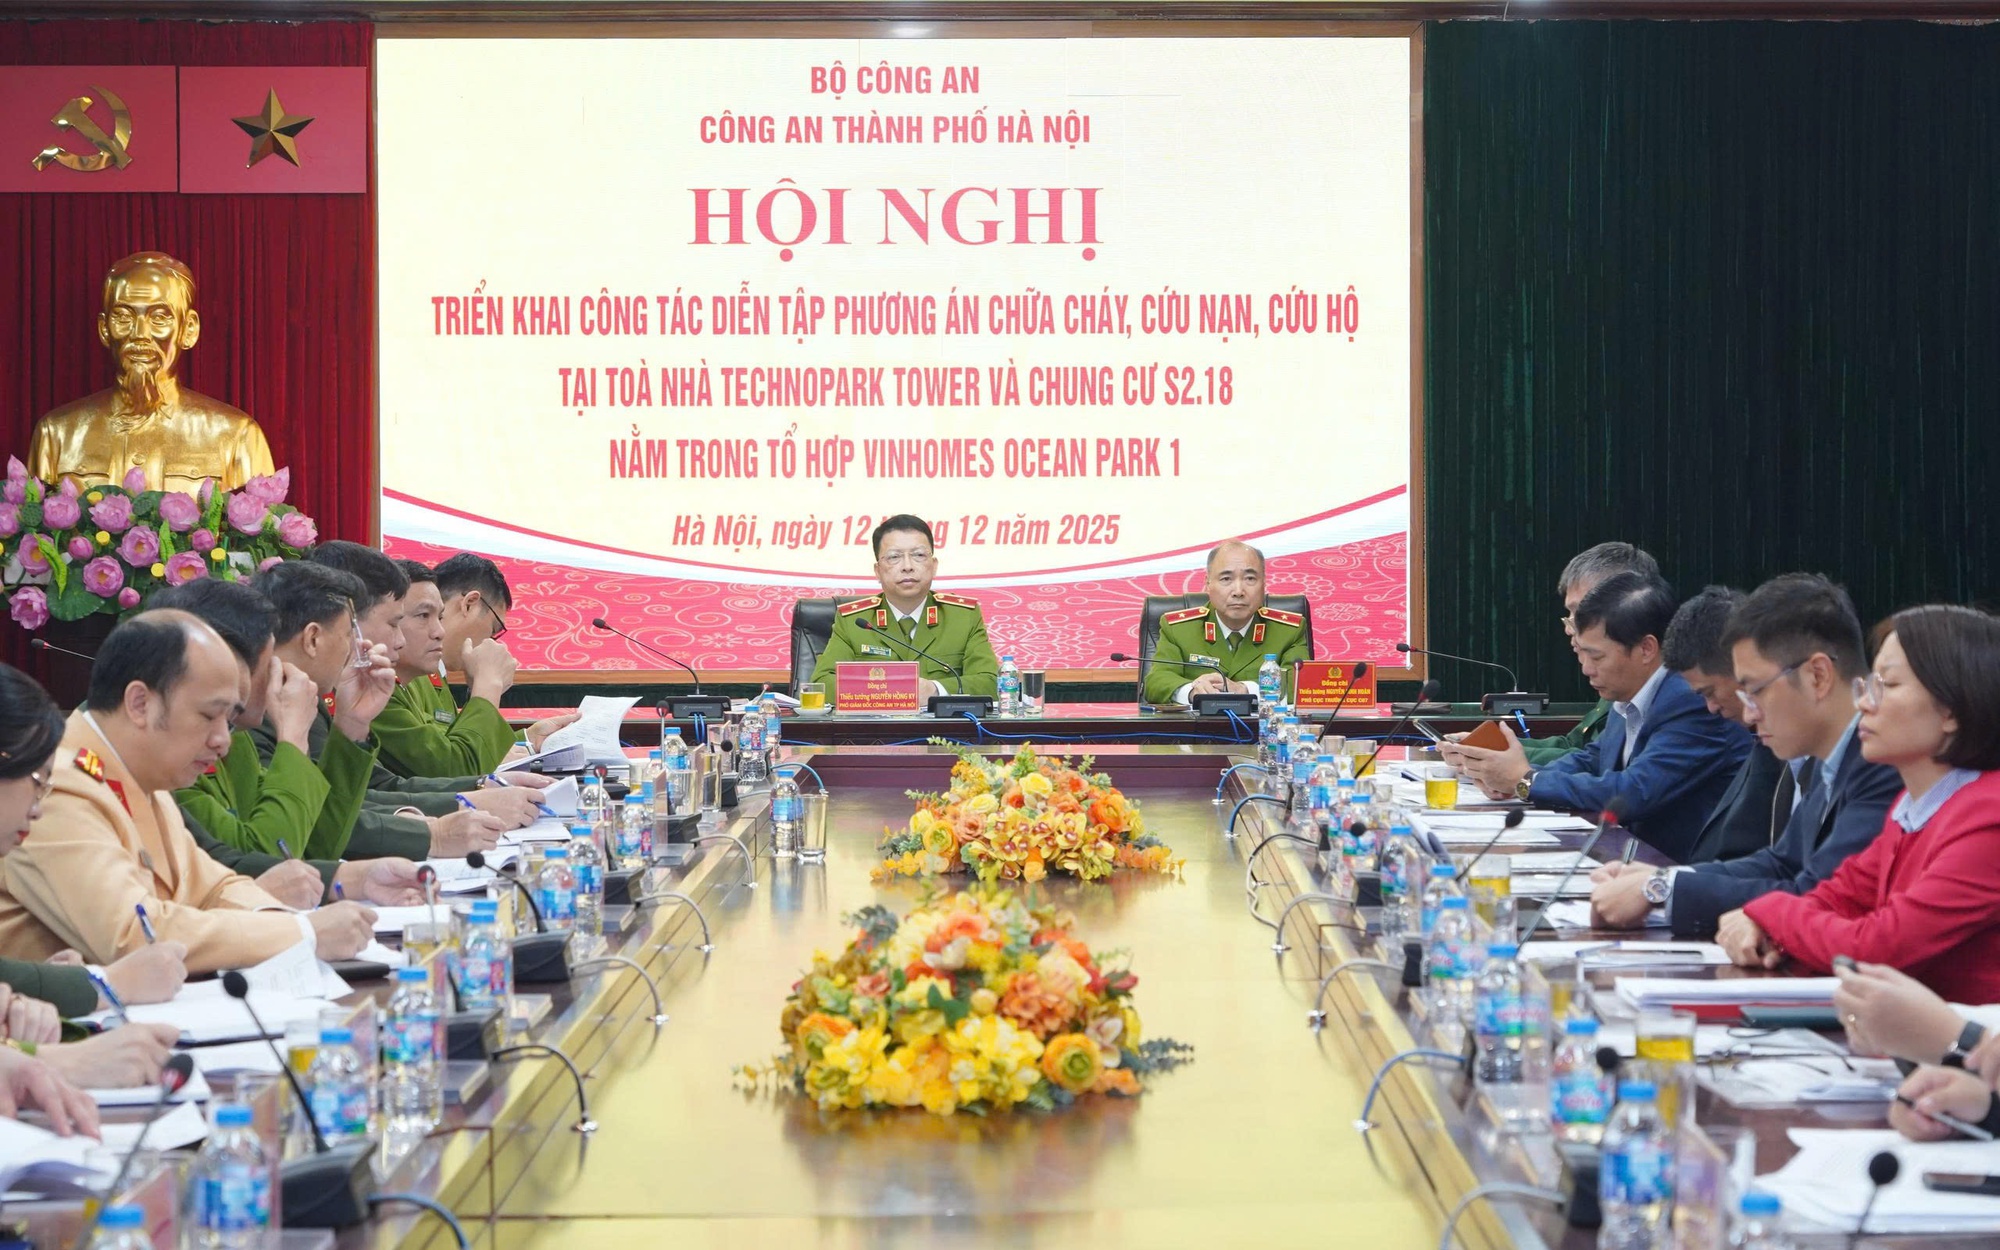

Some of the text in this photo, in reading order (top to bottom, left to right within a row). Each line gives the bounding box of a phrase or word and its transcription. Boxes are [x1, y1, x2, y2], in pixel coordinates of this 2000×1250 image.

[811, 60, 979, 100] BỘ CÔNG AN
[700, 106, 1090, 149] CÔNG AN THÀNH PHỐ HÀ NỘI
[687, 178, 1103, 262] HỘI NGHỊ
[431, 279, 1359, 344] TRIỂN KHAI CÔNG TÁC DIỄN TẬP PHƯƠNG ÁN CHỮA CHÁY, CỨU NẠN, CỨU HỘ
[558, 358, 1233, 416] TẠI TOÀ NHÀ TECHNOPARK TOWER VÀ CHUNG CƯ S2.18
[610, 422, 1179, 487] NẰM TRONG TỔ HỢP VINHOMES OCEAN PARK 1
[672, 515, 705, 546] Hà
[713, 514, 762, 552] Nội,
[771, 514, 833, 550] ngày
[843, 515, 872, 545] 12
[960, 514, 988, 545] 12
[995, 514, 1050, 545] năm
[1057, 514, 1120, 545] 2025
[870, 691, 892, 700] NGUYỄN
